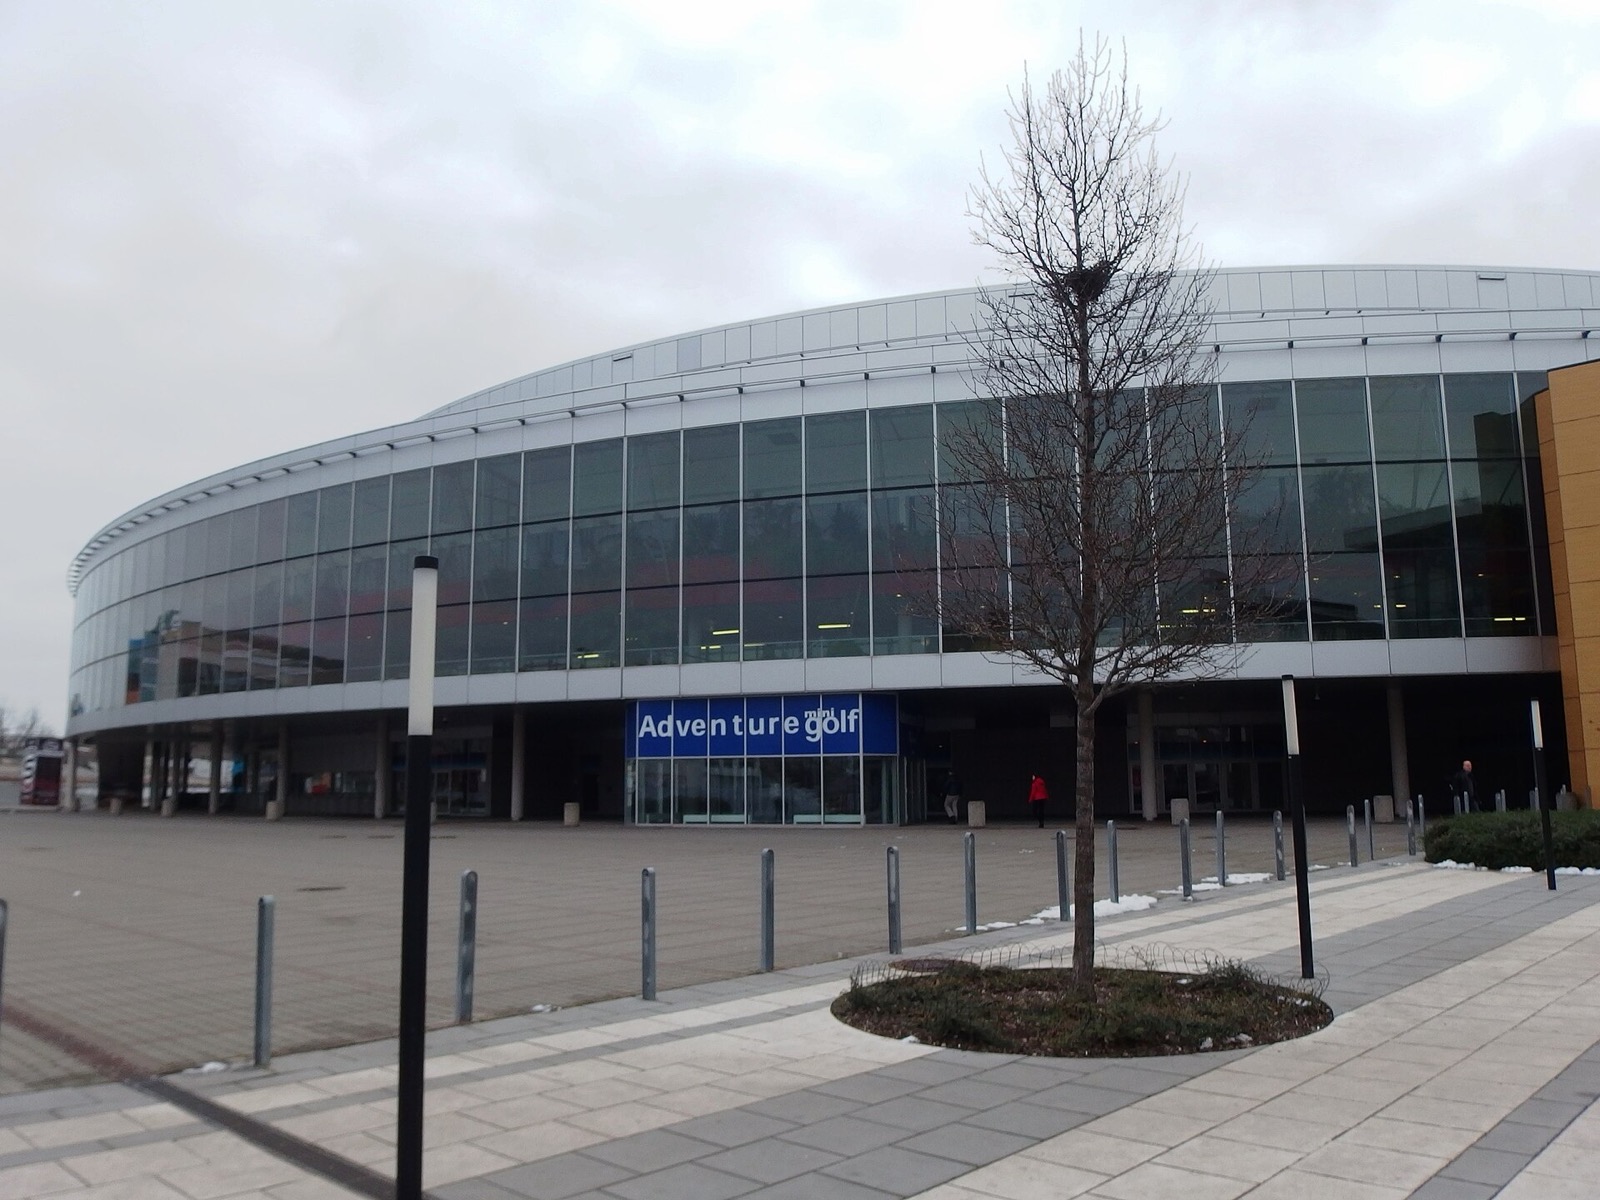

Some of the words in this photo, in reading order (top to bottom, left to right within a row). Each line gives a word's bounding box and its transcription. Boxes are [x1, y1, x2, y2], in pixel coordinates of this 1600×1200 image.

[804, 707, 834, 718] mini
[638, 714, 800, 738] Adventure
[804, 708, 860, 743] golf
